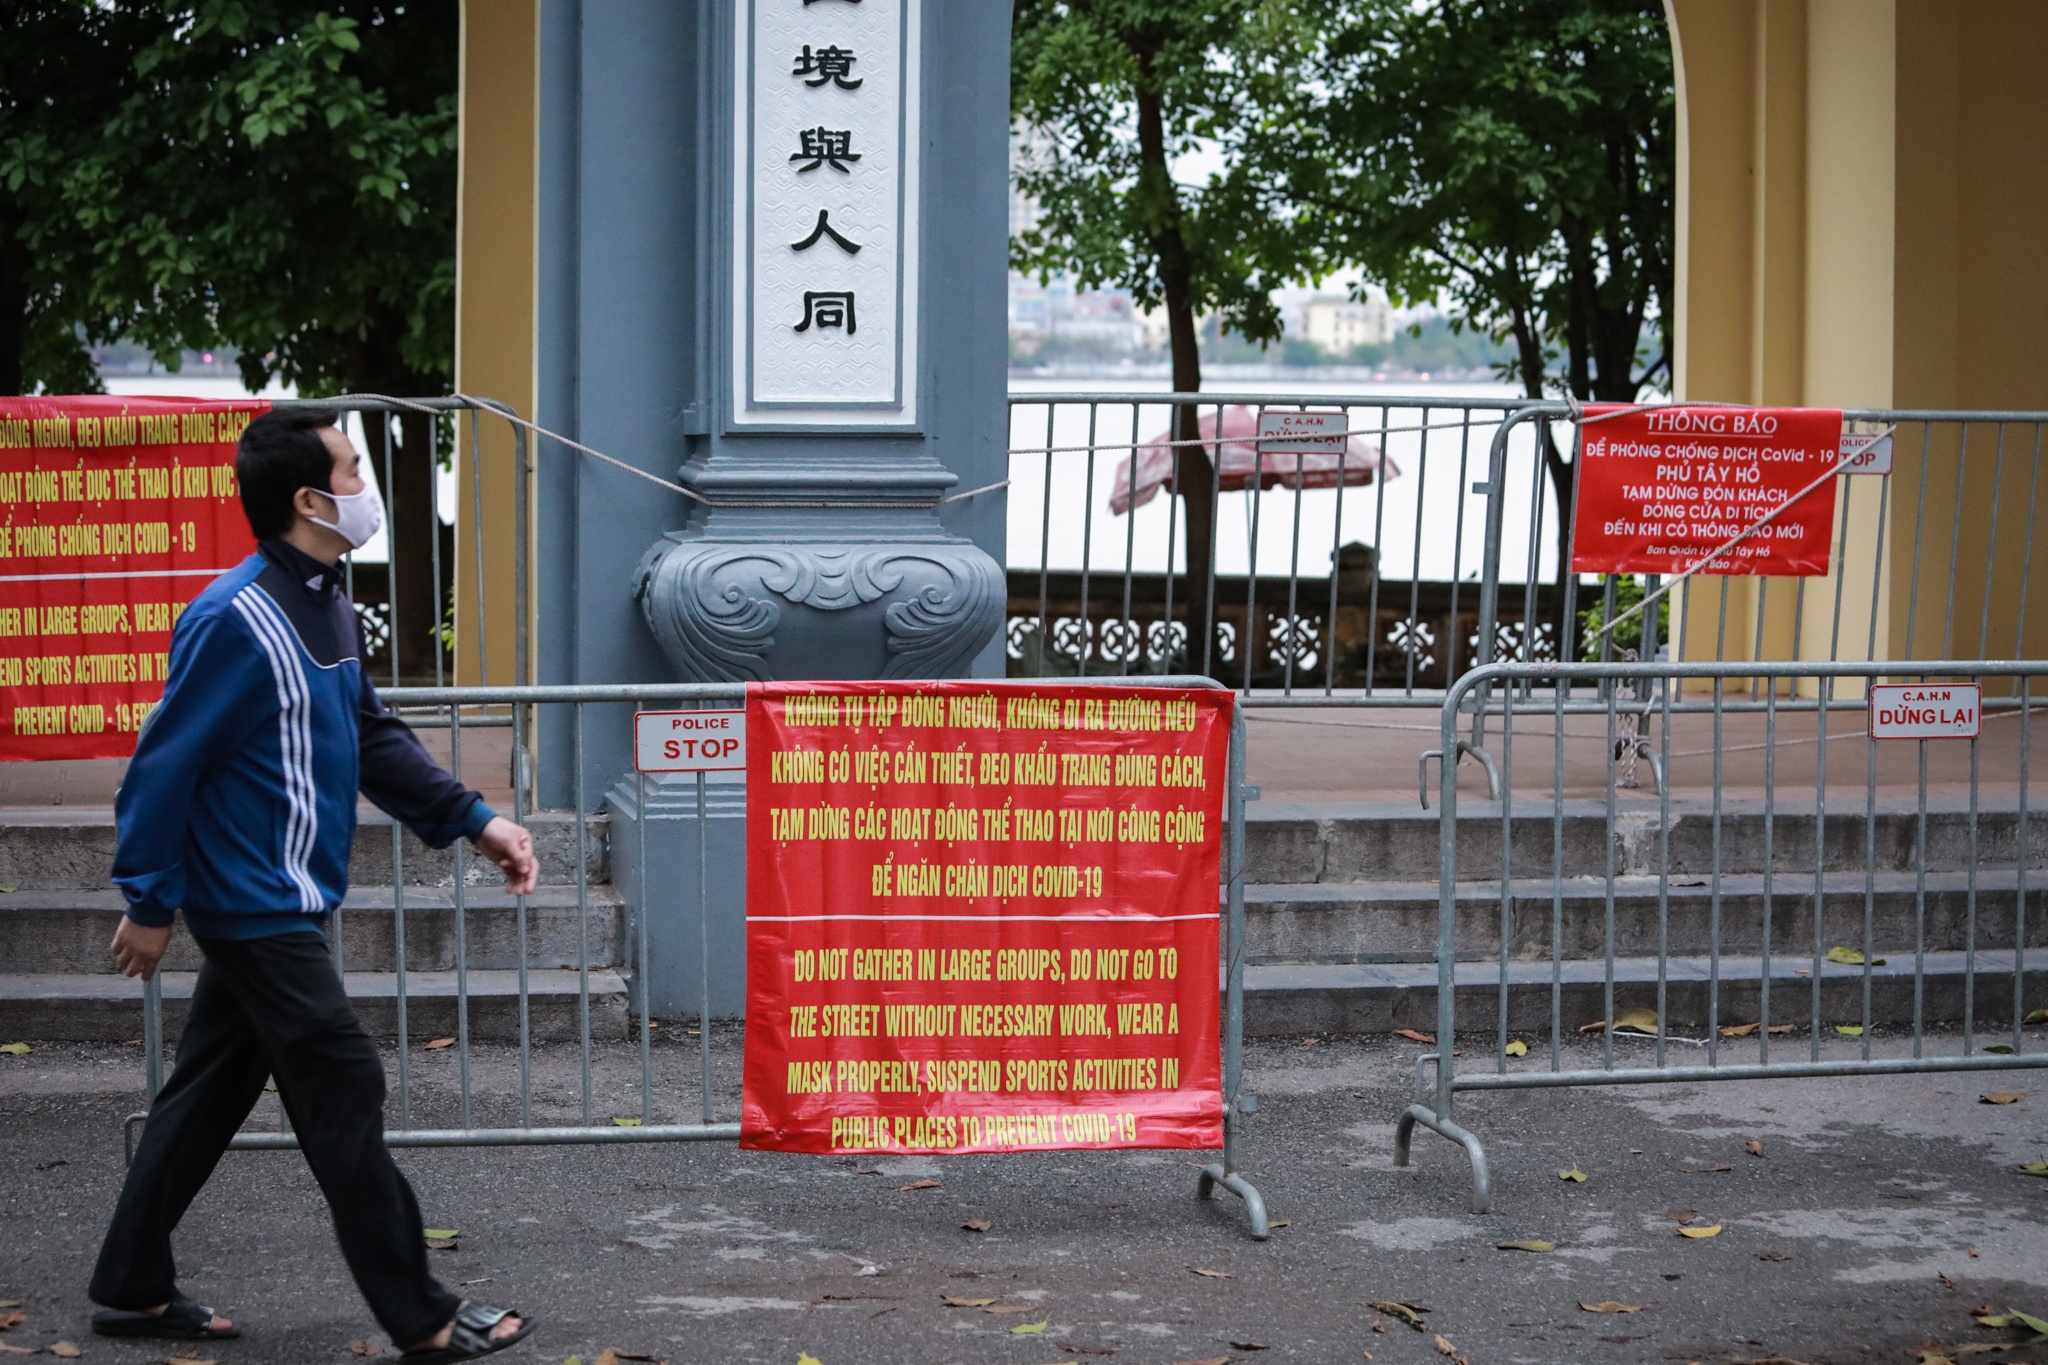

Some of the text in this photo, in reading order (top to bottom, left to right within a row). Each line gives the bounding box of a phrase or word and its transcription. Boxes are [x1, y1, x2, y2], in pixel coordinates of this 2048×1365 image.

[790, 45, 862, 334] 境與人同
[77, 416, 100, 448] ĐEO
[104, 405, 136, 447] KHẨU
[139, 413, 178, 445] TRANG
[182, 408, 215, 444] ĐÚNG
[1645, 410, 1778, 434] THÔNG BÁO
[1586, 437, 1606, 457] ĐỂ
[1610, 441, 1661, 458] PHÒNG
[1665, 441, 1719, 459] CHỐNG
[1723, 448, 1758, 462] DỊCH
[1819, 450, 1835, 463] 19
[1840, 452, 1876, 467] TOP
[1841, 439, 1872, 447] OLIC
[25, 464, 59, 510] ĐỘNG
[61, 457, 84, 502] THỂ
[86, 468, 111, 508] DỤC
[113, 456, 136, 500] THỂ
[138, 467, 169, 499] THAO
[172, 456, 181, 499] Ở
[184, 466, 208, 498] KHU
[211, 463, 234, 504] VỰC
[1656, 460, 1761, 483] PHỦ TÂY HỒ
[1623, 483, 1788, 502] TẠM DỪNG ĐÓN KHÁCH
[1643, 502, 1685, 518] ĐÓNG
[1689, 501, 1722, 519] CỬA
[1726, 506, 1740, 519] DI
[15, 518, 56, 558] PHÒNG
[59, 513, 100, 557] CHỐNG
[103, 523, 132, 561] DỊCH
[134, 521, 169, 554] COVID
[181, 521, 195, 553] 19
[1604, 520, 1635, 535] ĐẾN
[1638, 521, 1661, 536] KHI
[1665, 521, 1687, 537] CÓ
[1692, 520, 1739, 538] THÔNG
[1776, 522, 1804, 539] MỚI
[1647, 545, 1666, 555] Ban
[24, 607, 37, 636] IN
[40, 605, 78, 636] LARGE
[80, 603, 132, 635] GROUPS,
[134, 602, 170, 632] WEAR
[26, 655, 71, 686] SPORTS
[74, 653, 136, 684] ACTIVITIES
[140, 653, 152, 682] IN
[14, 705, 66, 736] PREVENT
[70, 703, 104, 735] COVID
[116, 703, 130, 733] 19
[672, 718, 730, 729] POLICE
[785, 689, 1196, 735] KHÔNG TỤ TẬP ĐÔNG NGƯỜI, KHÔNG ĐI RA ĐƯỜNG NẾU
[1880, 704, 1972, 727] DỪNG LẠI
[663, 738, 739, 759] STOP
[772, 740, 1206, 791] KHÔNG CÓ VIỆC CẦN THIẾT, ĐEO KHẨU TRANG ĐÚNG CÁCH,
[771, 796, 1205, 851] TẠM DỪNG CÁC HOẠT ĐỘNG THỂ THAO TẠI NƠI CÔNG CỘNG
[872, 851, 1102, 905] ĐỂ NGĂN CHẶN DỊCH COVID-19
[795, 947, 1177, 985] DO NOT GATHER IN LARGE GROUPS, DO NOT GO TO
[791, 1003, 1178, 1039] THE STREET WITHOUT NECESSARY WORK, WEAR A
[787, 1057, 1178, 1096] MASK PROPERLY, SUSPEND SPORTS ACTIVITIES IN
[832, 1112, 1136, 1149] PUBLIC PLACES TO PREVENT COVID-19
